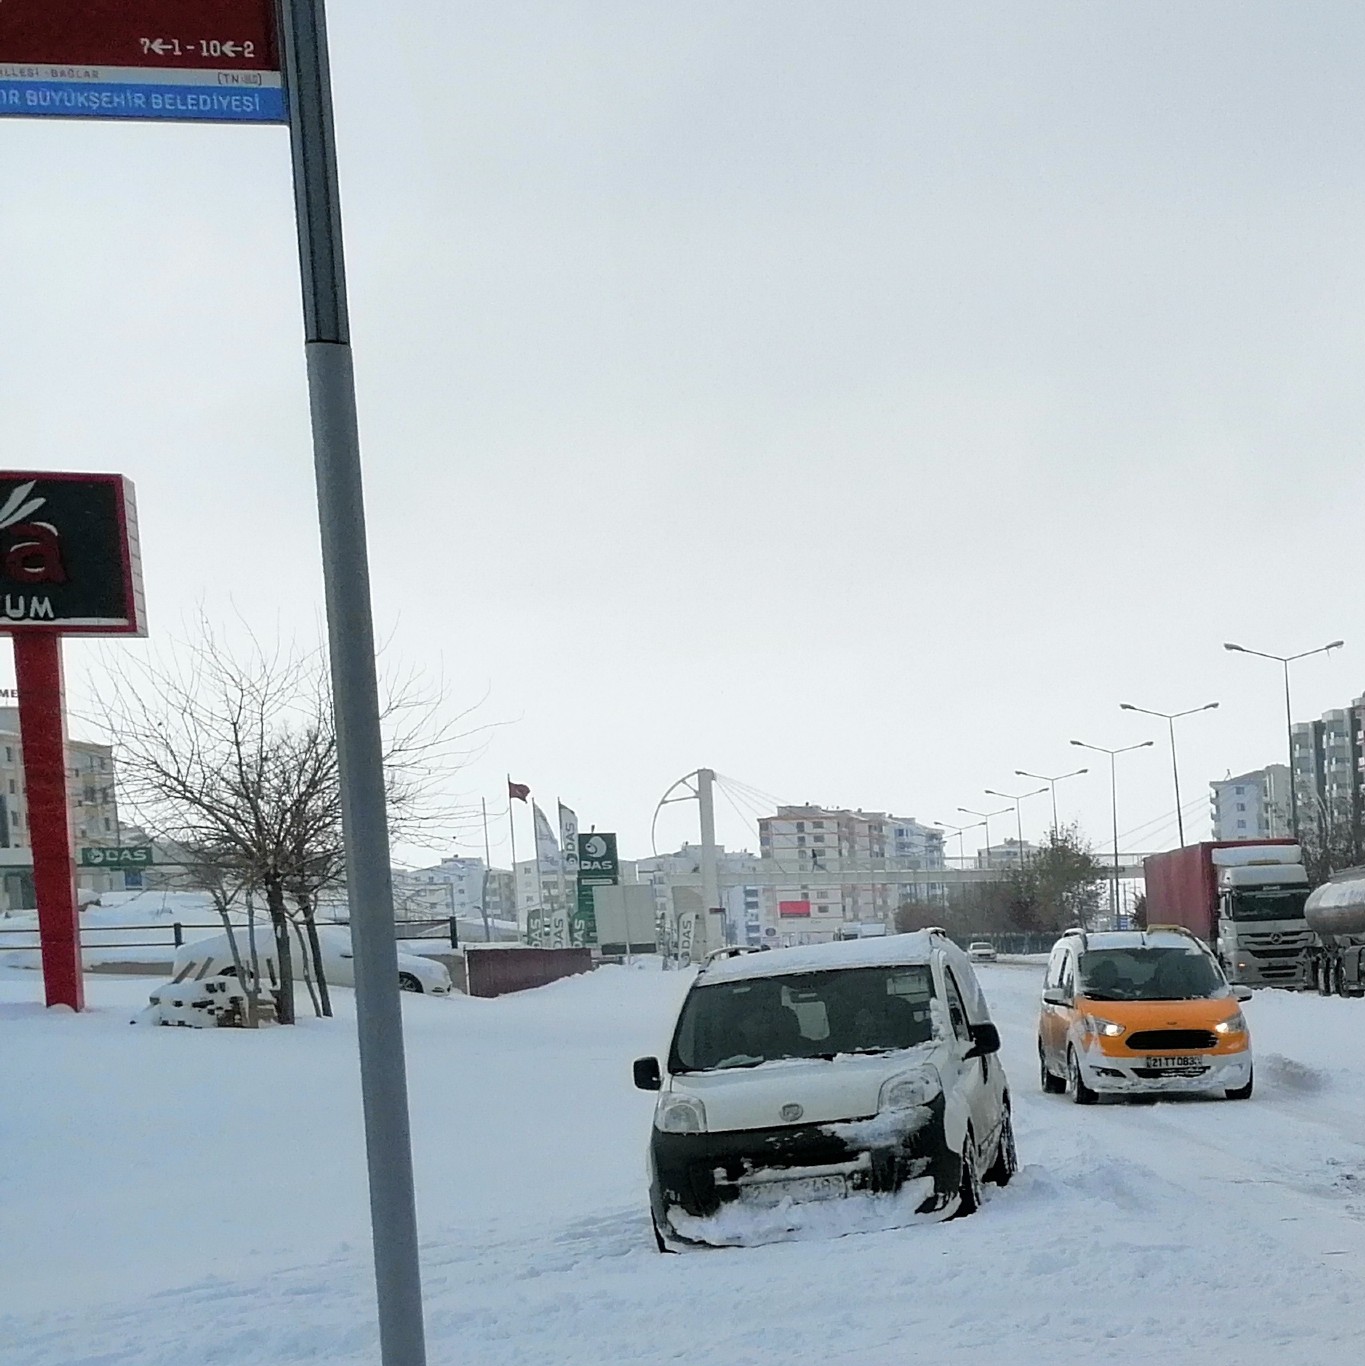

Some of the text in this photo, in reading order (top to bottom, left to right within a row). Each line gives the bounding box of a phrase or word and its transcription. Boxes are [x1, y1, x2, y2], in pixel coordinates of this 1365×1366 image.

[0, 66, 39, 78] LLESİ
[25, 87, 146, 110] BÜYÜKŞEHİR
[151, 92, 260, 112] BELEDİYESİ
[0, 593, 54, 618] UM
[580, 860, 613, 870] DAS
